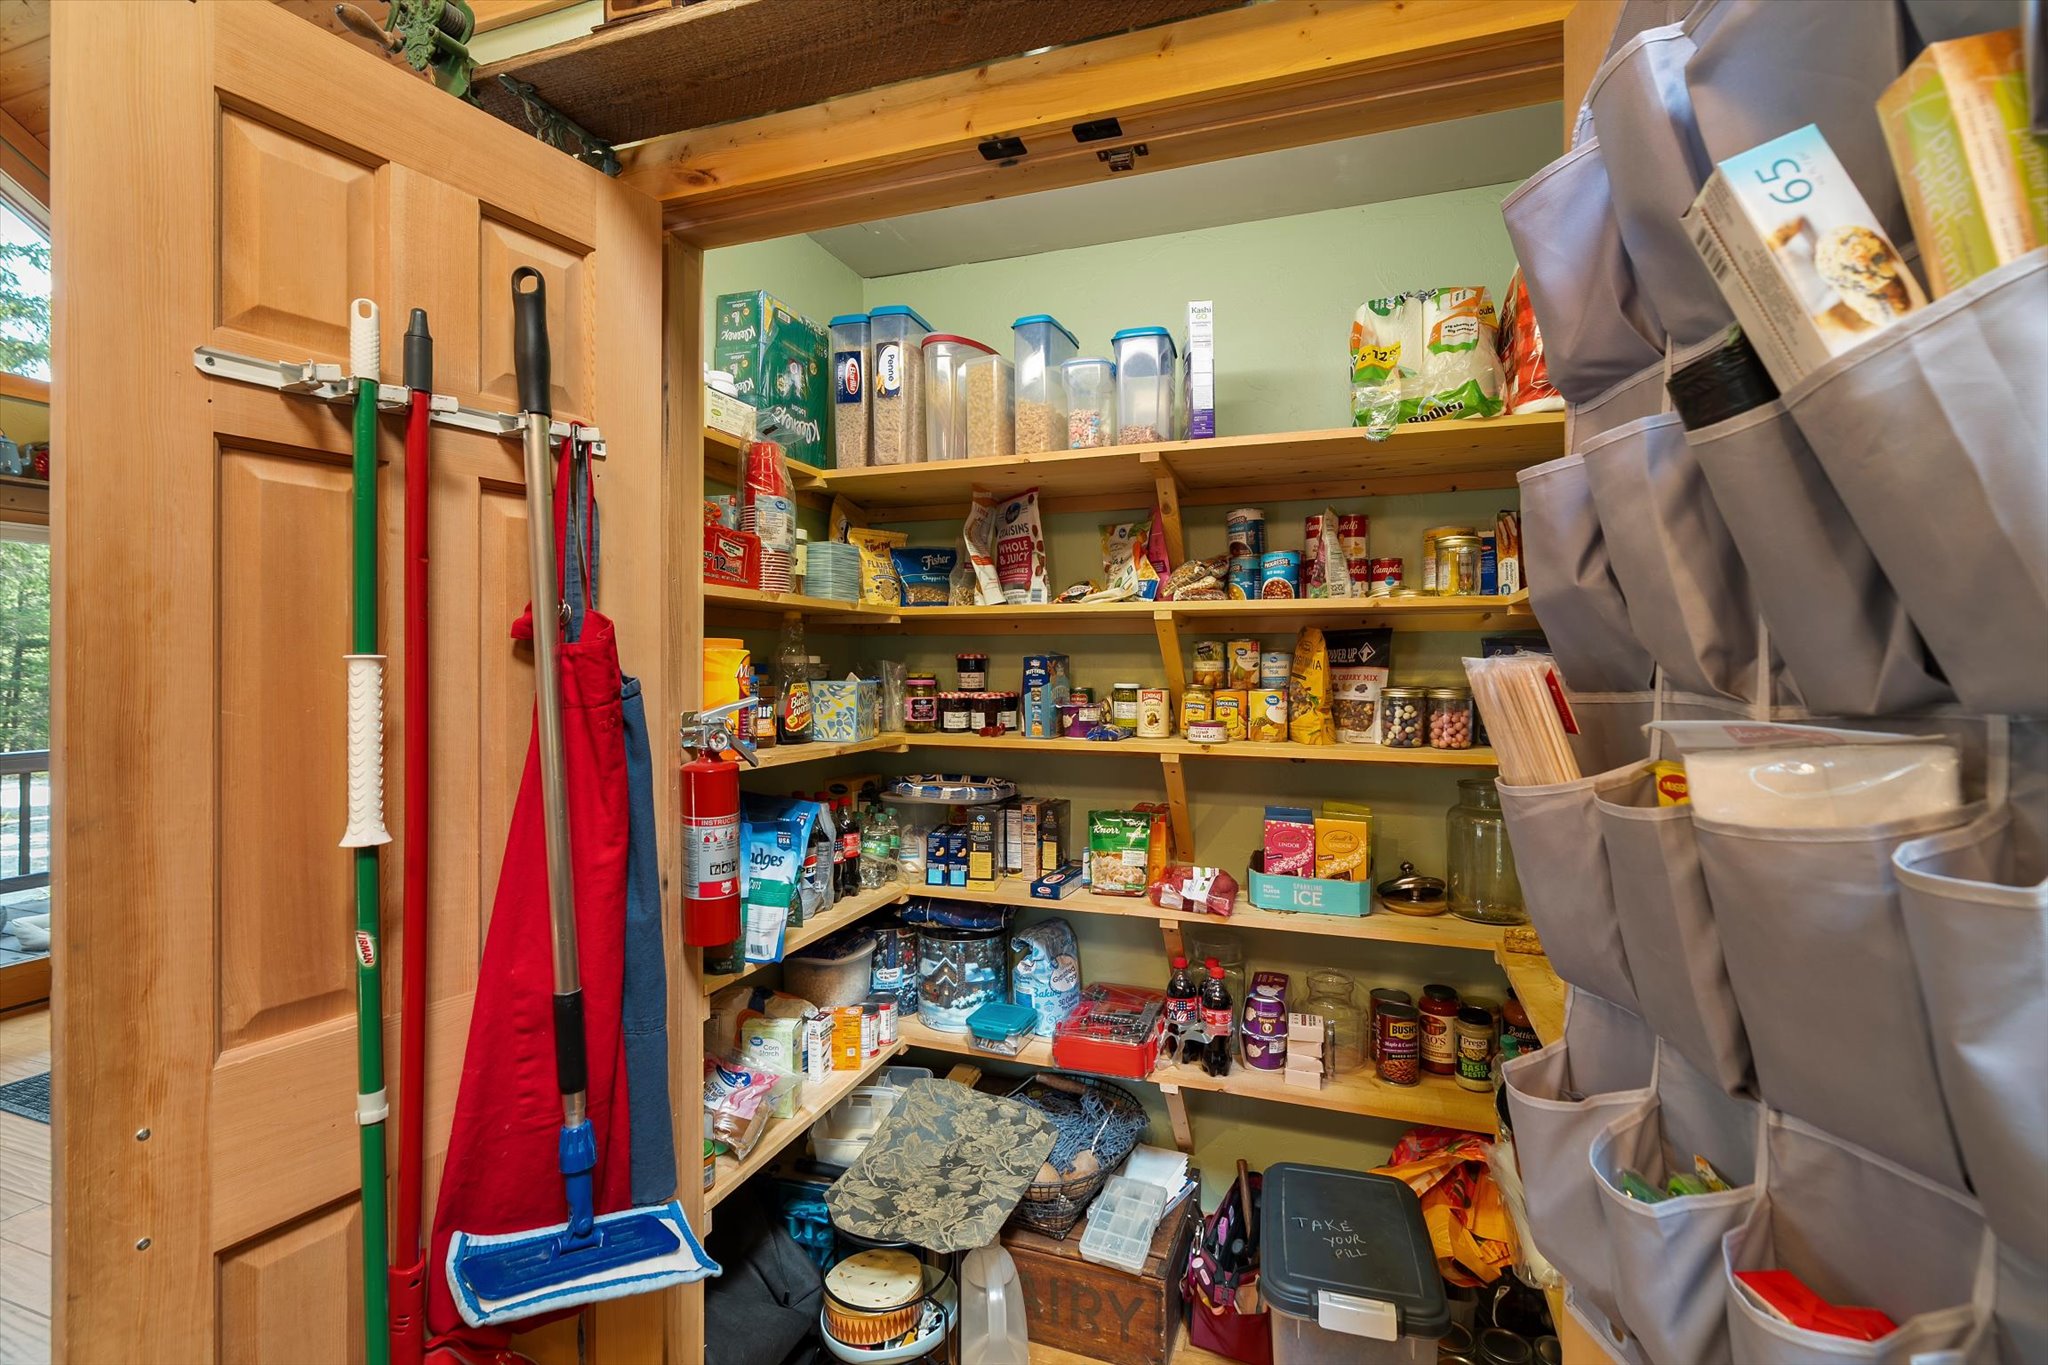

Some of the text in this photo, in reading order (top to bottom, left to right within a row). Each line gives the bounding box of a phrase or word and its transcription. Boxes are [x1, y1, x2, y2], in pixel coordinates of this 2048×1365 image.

[1755, 158, 1812, 204] 65
[1191, 306, 1211, 314] Kashi
[721, 325, 756, 342] Kleenex
[887, 354, 895, 382] Penne
[735, 378, 755, 393] Klee
[772, 406, 820, 444] Kleenex
[999, 540, 1029, 553] WHOLE
[715, 556, 726, 570] 12
[922, 555, 951, 570] Fisher
[1000, 552, 1030, 565] & JUICY
[1328, 647, 1358, 660] OWER UP
[758, 706, 773, 718] Jif
[1093, 824, 1120, 835] Knorr
[778, 837, 791, 845] USA
[750, 848, 785, 870] udges
[1293, 883, 1323, 891] SPARKLING
[1294, 890, 1323, 906] ICE
[356, 931, 374, 964] LIBMAN
[1463, 1038, 1487, 1048] Prego
[1462, 1064, 1488, 1072] BASIL
[1290, 1216, 1353, 1232] TAKE
[1323, 1234, 1366, 1245] YOUR
[1335, 1248, 1368, 1259] PILL
